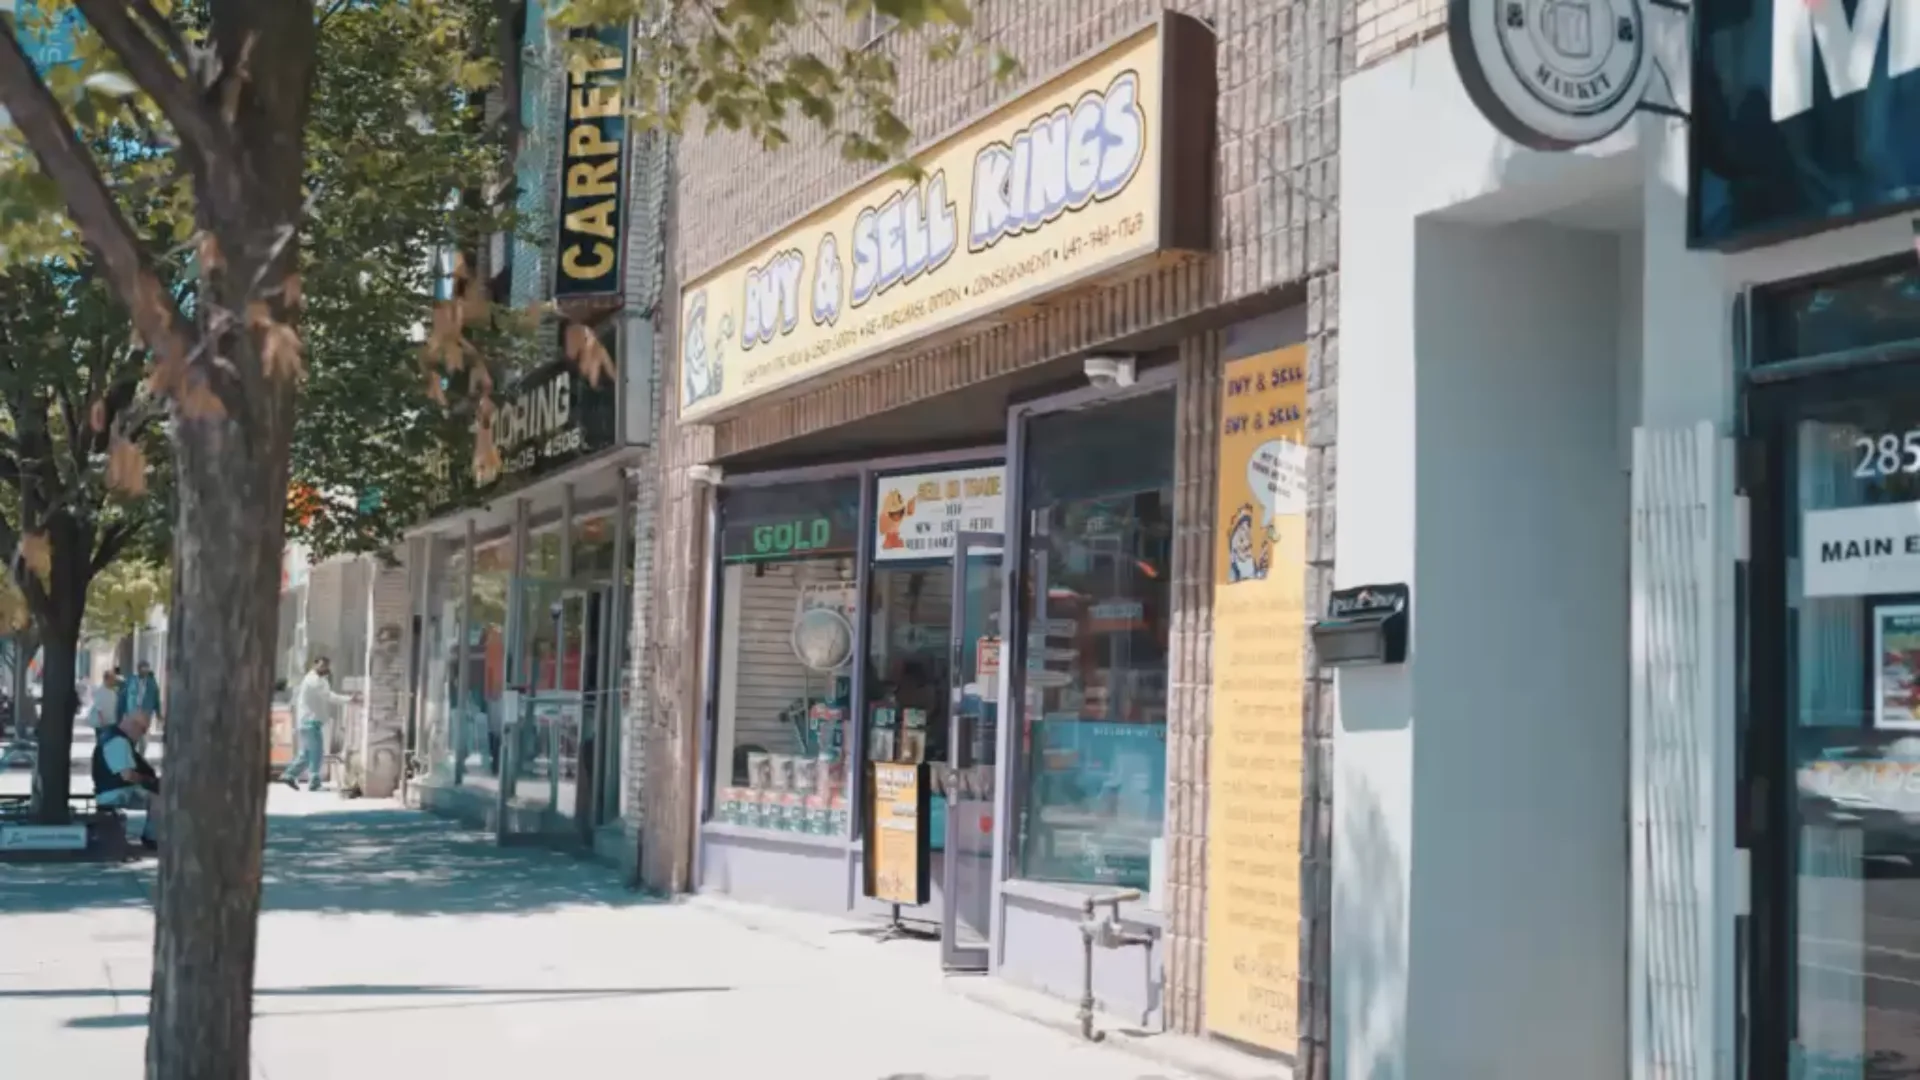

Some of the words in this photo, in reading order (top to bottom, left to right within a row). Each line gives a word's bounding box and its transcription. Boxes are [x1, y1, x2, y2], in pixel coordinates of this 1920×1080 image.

[1536, 63, 1612, 99] MARKET
[740, 247, 804, 351] BUY
[811, 232, 844, 327] &
[851, 168, 958, 310] SELL
[968, 68, 1147, 254] KINGS
[972, 248, 1052, 297] CONSIGNMENT
[753, 518, 831, 552] GOLD
[1820, 537, 1893, 563] MAIN
